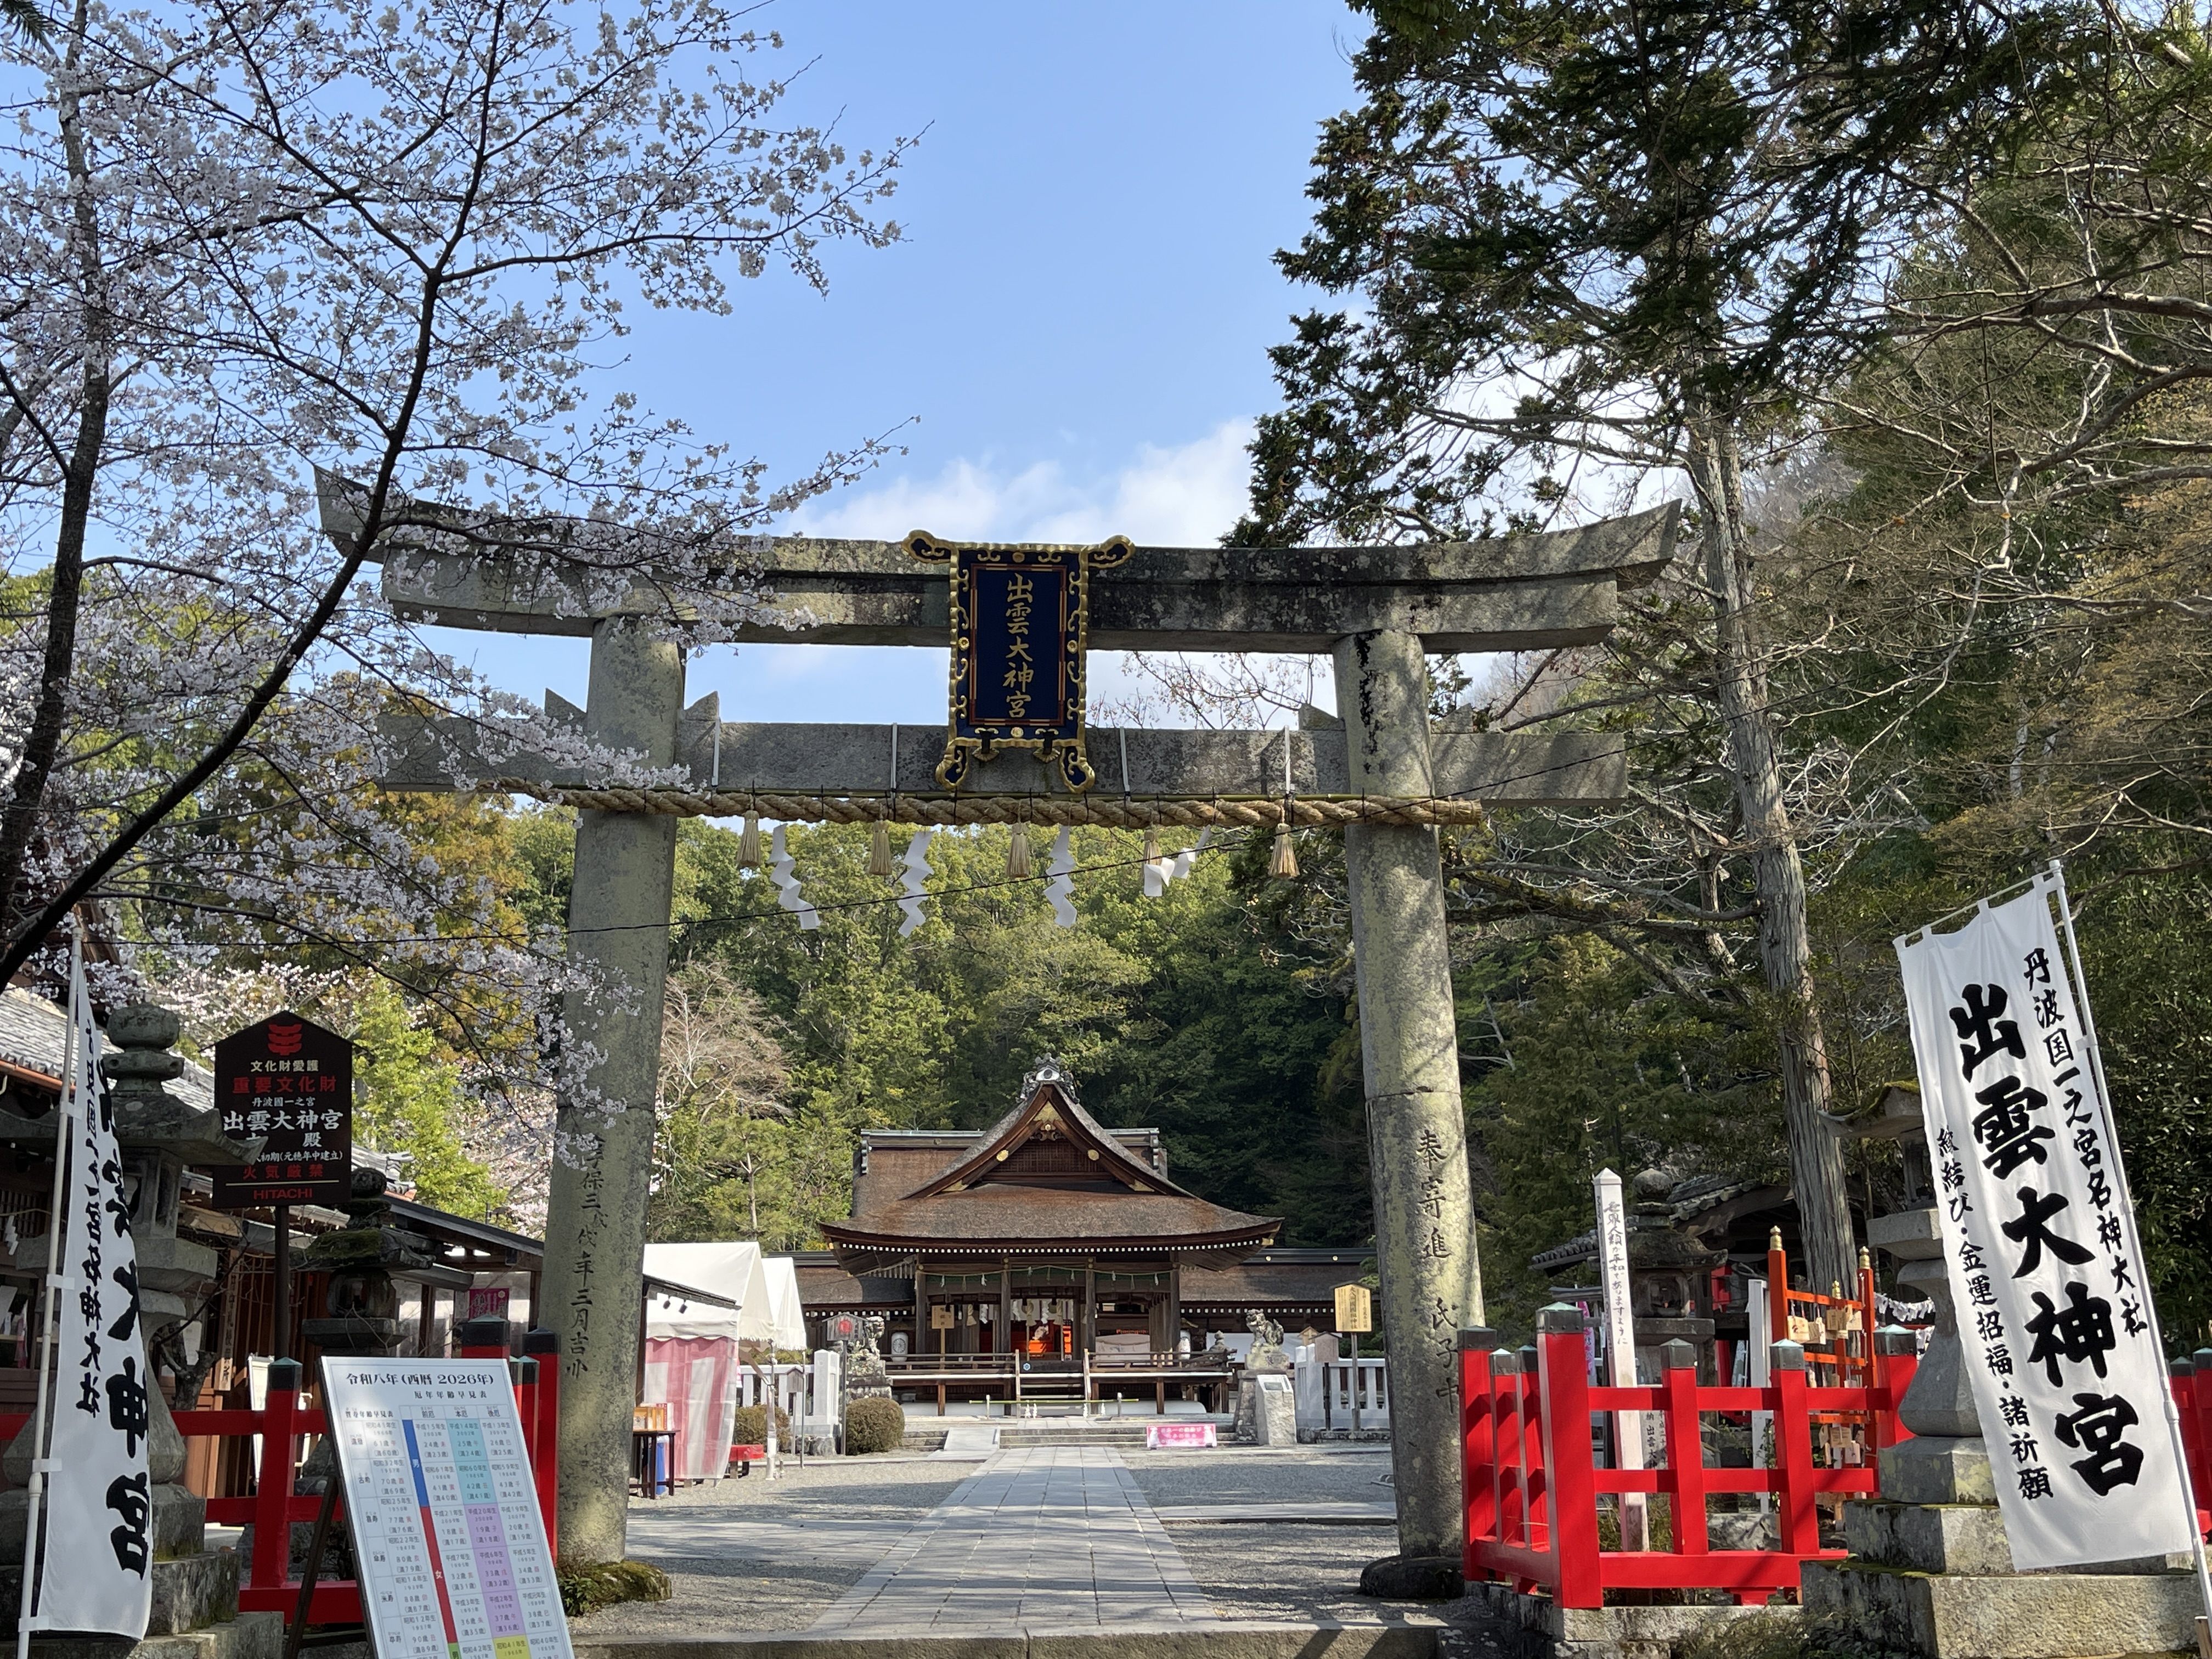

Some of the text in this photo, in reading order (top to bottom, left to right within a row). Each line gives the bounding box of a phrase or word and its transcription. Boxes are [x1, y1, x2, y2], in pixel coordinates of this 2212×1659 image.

[1002, 573, 1034, 718] 出雲大神宮
[251, 1060, 319, 1072] 文化財愛護
[233, 1076, 336, 1094] 重要文化財
[223, 1109, 343, 1131] 出雲大神宮
[2023, 947, 2148, 1336] 丹波国一之宮名神大社
[243, 1164, 324, 1179] 火気厳禁
[253, 1188, 313, 1199] HITACHI
[1949, 982, 2144, 1497] 出雲大神宮
[1416, 1129, 1459, 1414] 奉寄進 氏子中
[1604, 1201, 1628, 1345] 世界人類が平和でありますように
[1936, 1125, 2054, 1501] 縁結び・金運招福・諸祈願
[346, 1373, 493, 1385] 令和八年(西暦 2026年)
[413, 1459, 420, 1468] 男
[435, 1570, 443, 1579] 女
